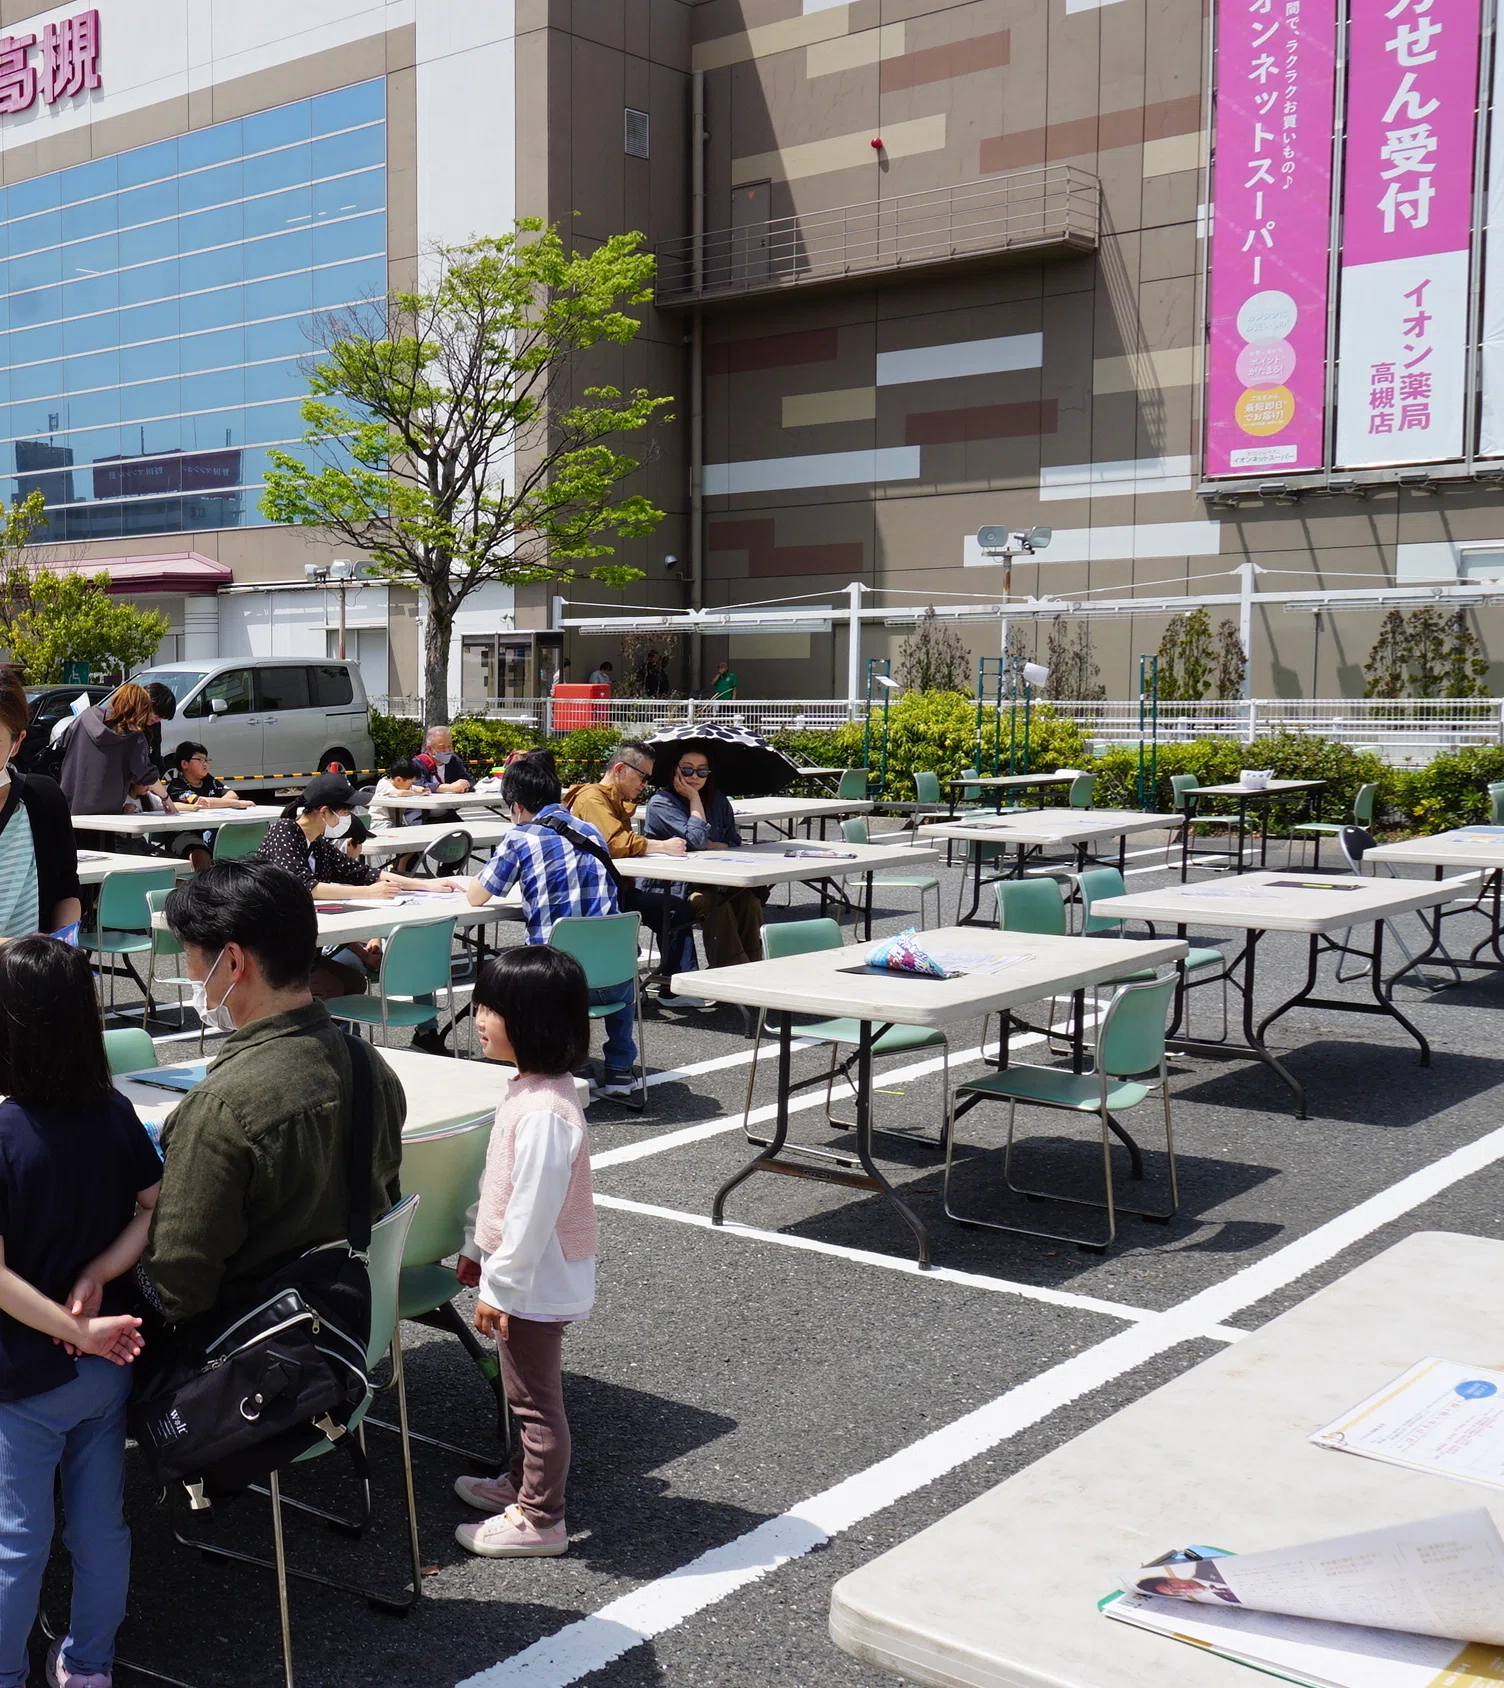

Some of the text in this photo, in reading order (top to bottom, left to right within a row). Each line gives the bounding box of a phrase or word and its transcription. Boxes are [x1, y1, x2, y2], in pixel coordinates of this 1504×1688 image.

[1368, 361, 1396, 435] 高槻店
[1398, 278, 1433, 431] イオン薬局
